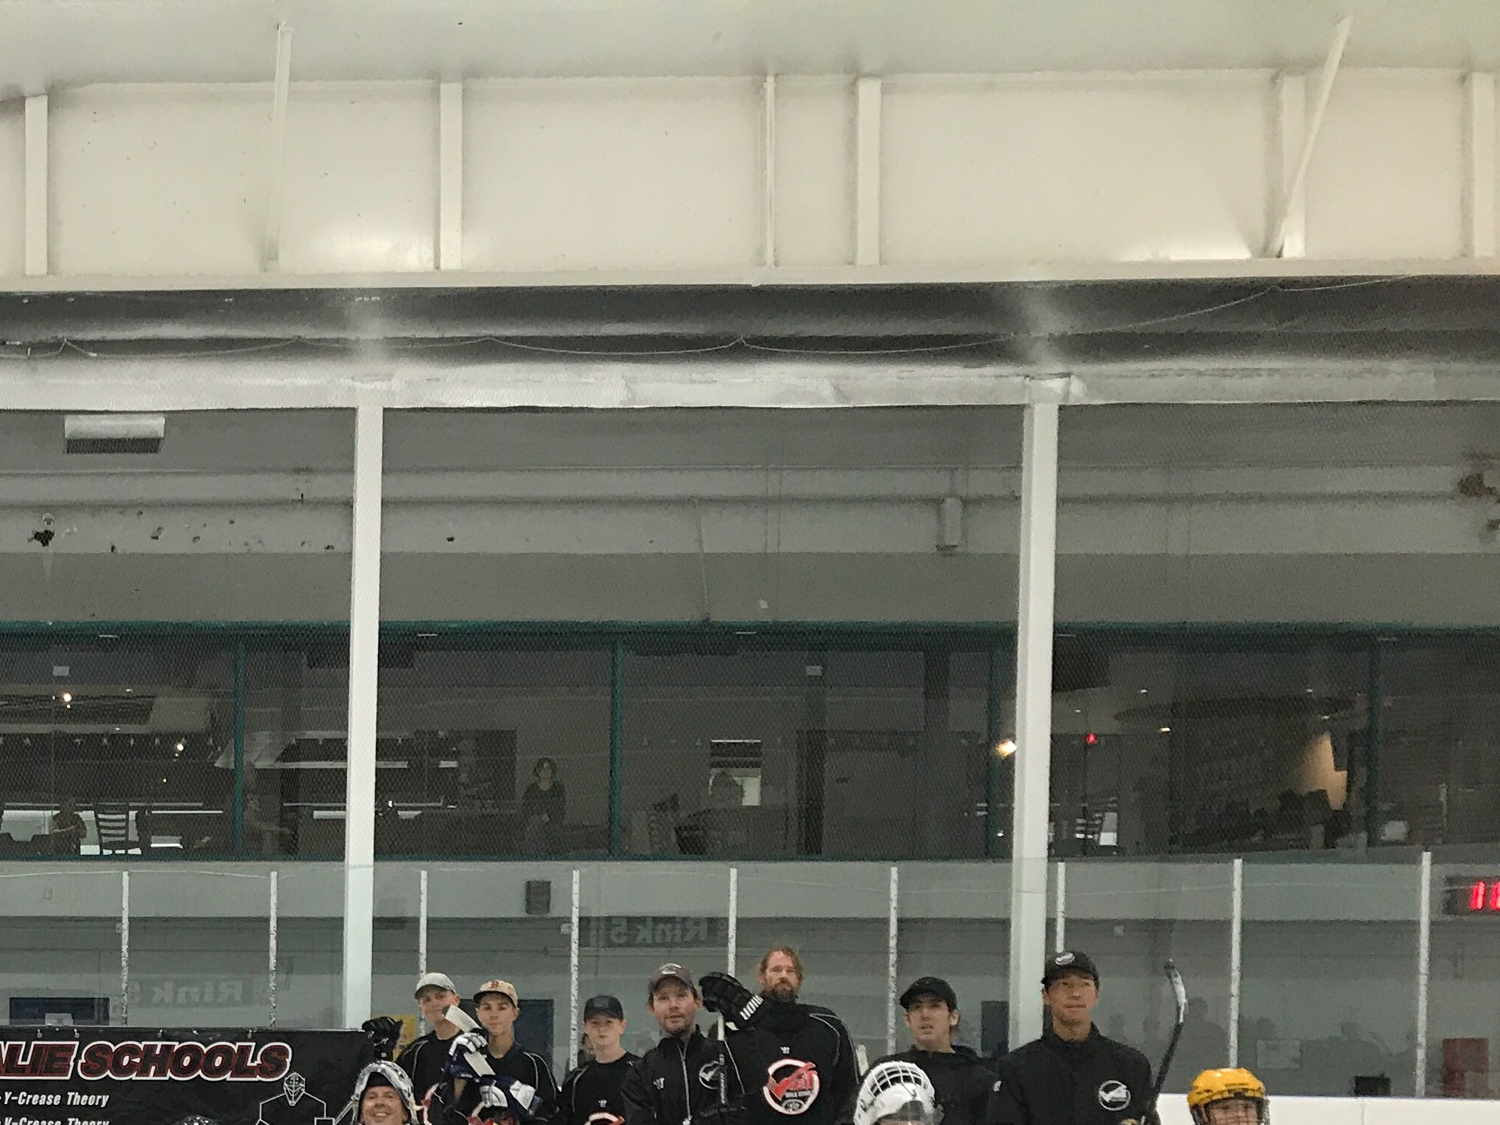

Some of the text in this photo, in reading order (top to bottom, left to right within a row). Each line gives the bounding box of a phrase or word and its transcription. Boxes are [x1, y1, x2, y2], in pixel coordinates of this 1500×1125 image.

[78, 1041, 293, 1082] SCHOOLS
[3, 1091, 110, 1108] Y-Crease Theory
